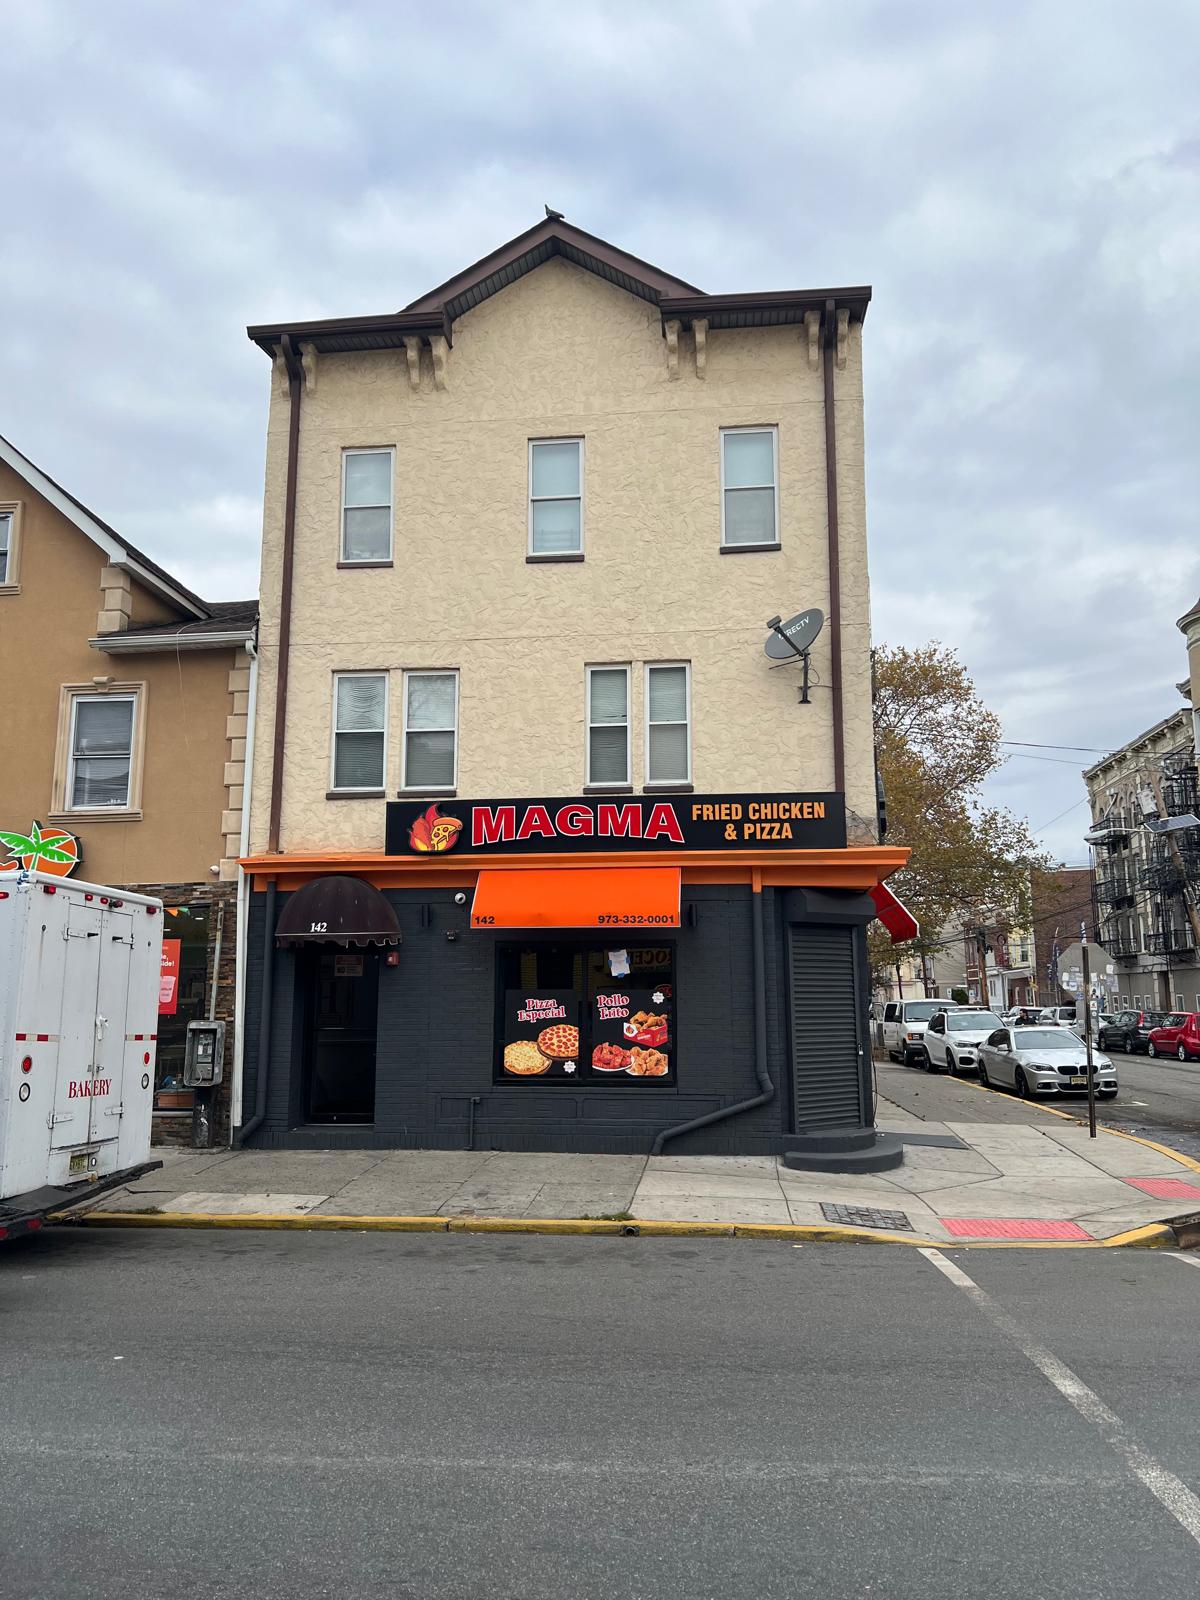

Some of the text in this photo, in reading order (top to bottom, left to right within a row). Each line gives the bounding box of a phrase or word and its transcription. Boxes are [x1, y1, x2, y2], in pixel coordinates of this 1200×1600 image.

[692, 802, 825, 820] FRIED CHICKEN
[472, 803, 685, 846] MAGMA
[724, 822, 793, 840] & PIZZA
[475, 915, 495, 924] 142
[597, 915, 675, 924] 973-332-0001
[310, 922, 327, 932] 142
[526, 999, 557, 1010] Pizza
[597, 994, 630, 1007] Pollo
[518, 1006, 566, 1023] Especial
[599, 1007, 629, 1020] Frito
[68, 1079, 112, 1098] BAKERY
